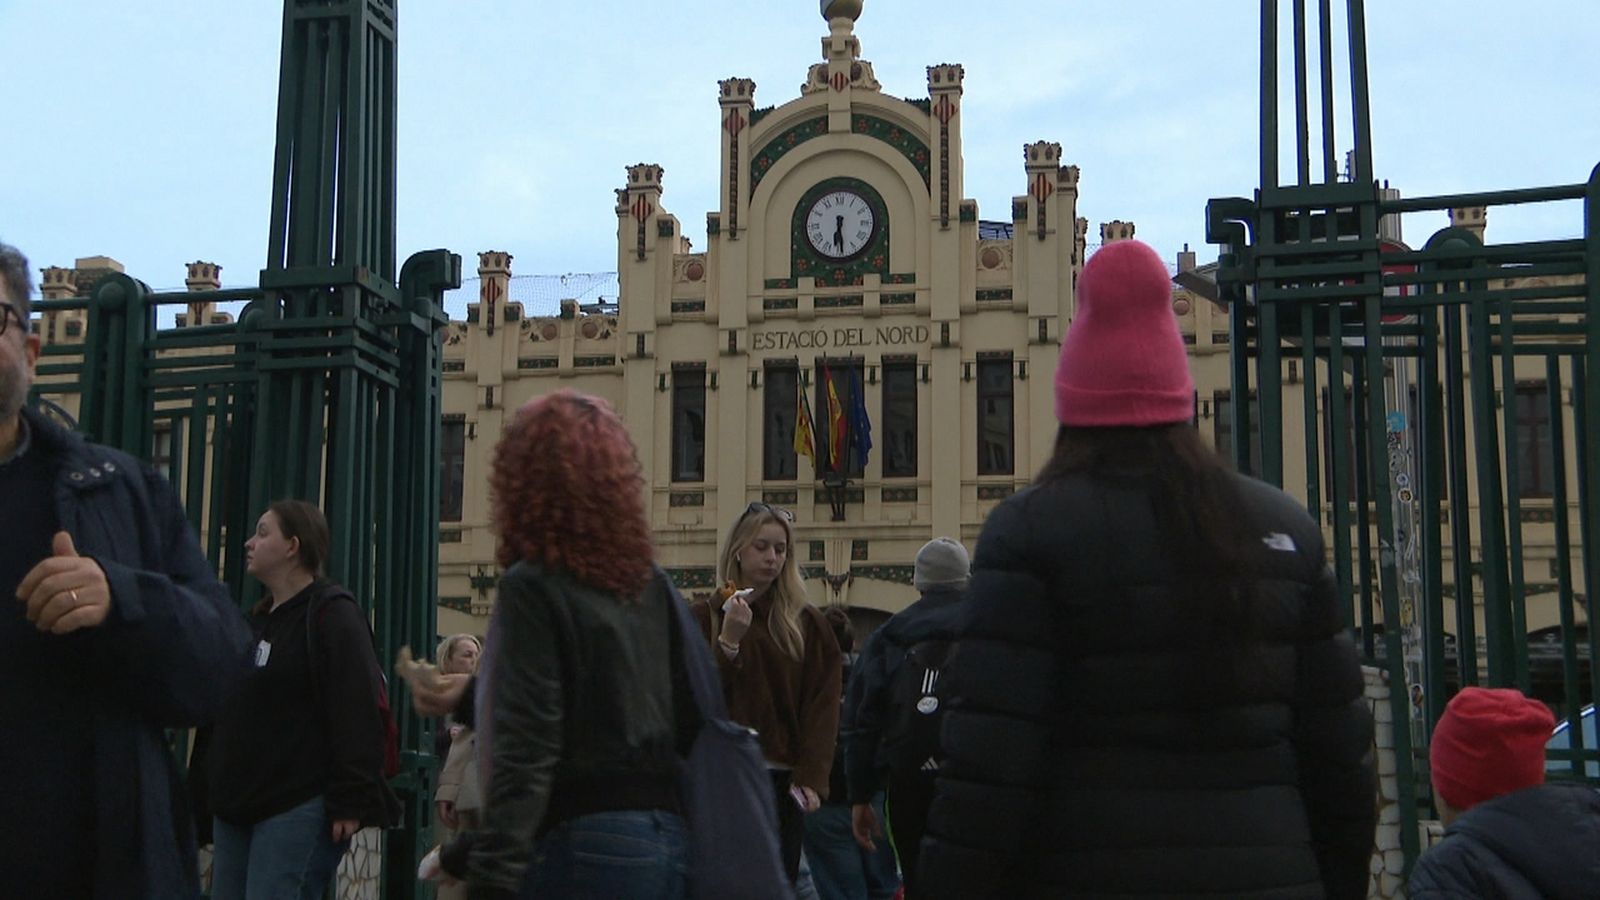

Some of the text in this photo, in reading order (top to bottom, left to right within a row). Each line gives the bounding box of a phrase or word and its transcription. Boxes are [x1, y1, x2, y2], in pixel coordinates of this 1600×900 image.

[752, 325, 929, 350] ESTACIÓ DEL NORD
